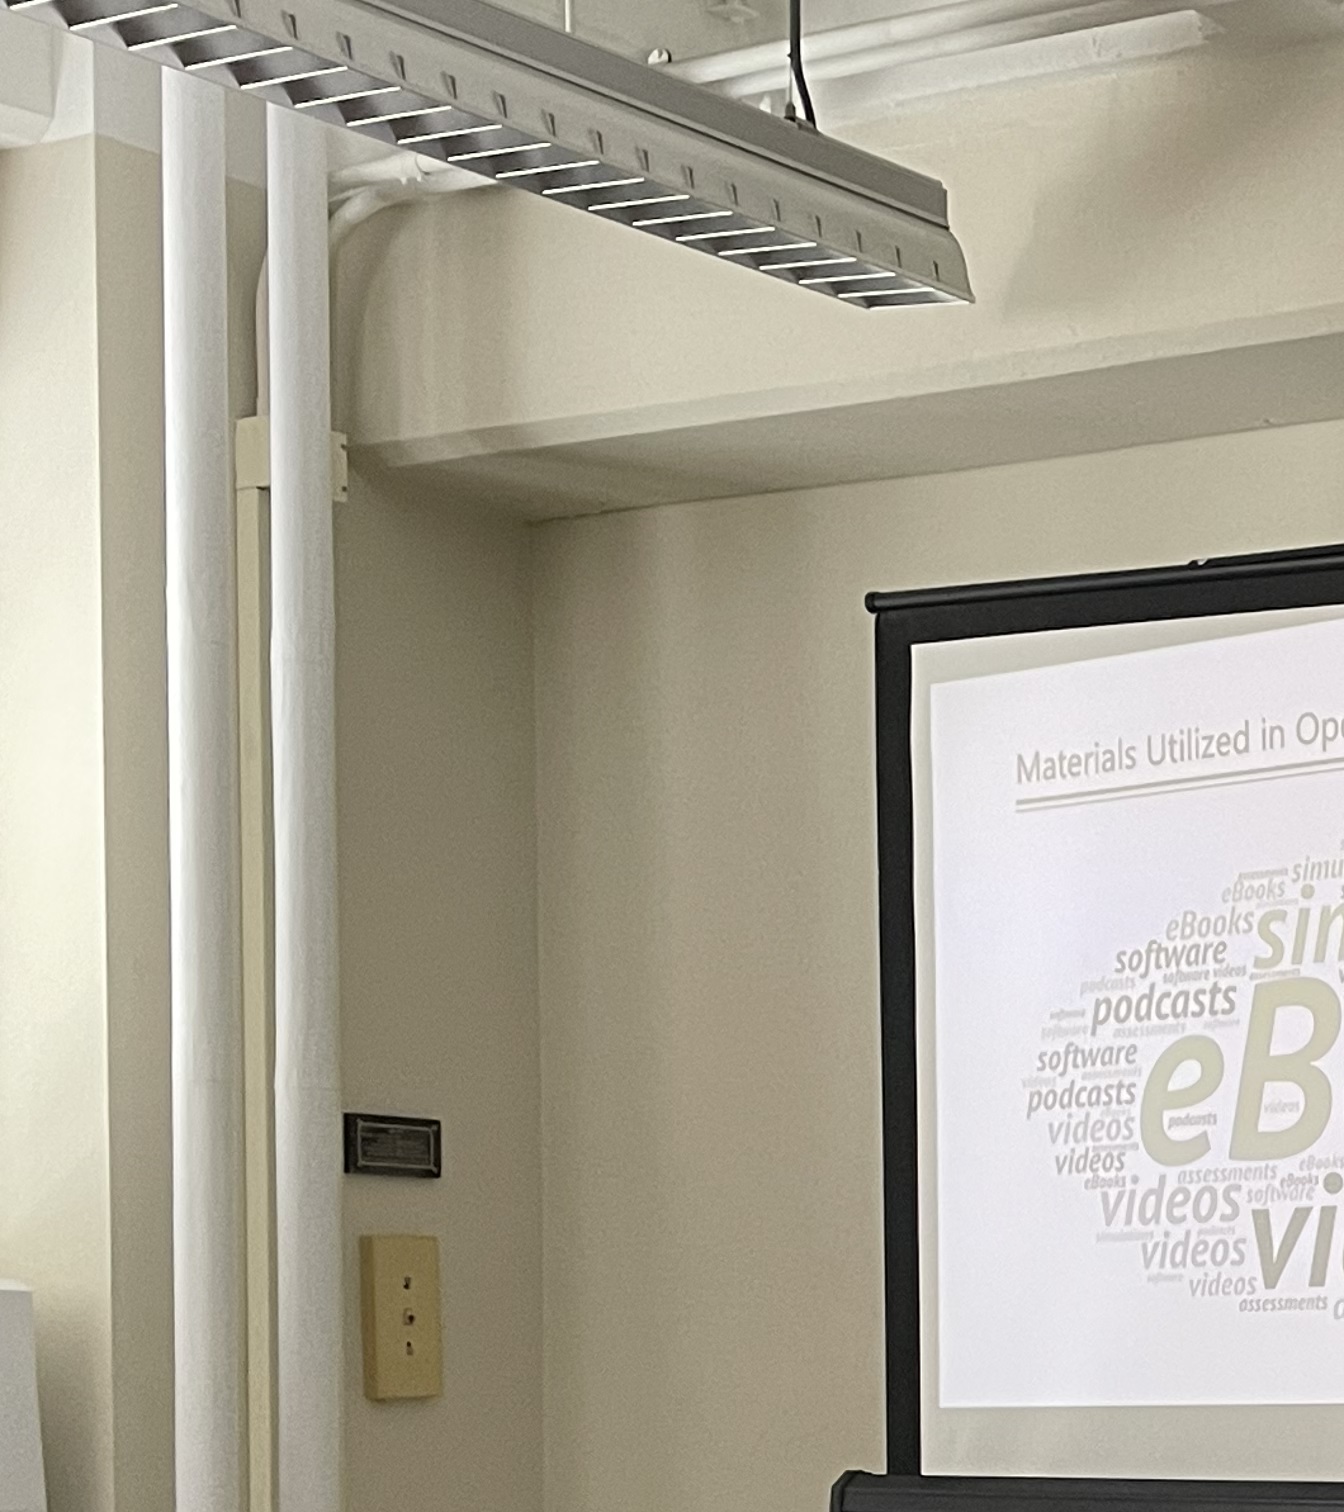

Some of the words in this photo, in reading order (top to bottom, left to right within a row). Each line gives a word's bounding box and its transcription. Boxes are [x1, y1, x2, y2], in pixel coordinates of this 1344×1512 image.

[1016, 737, 1137, 785] Materials
[1147, 720, 1250, 767] Utilized
[1261, 717, 1286, 751] in
[1221, 879, 1285, 903] eBooks
[1165, 906, 1254, 941] eBooks
[1114, 939, 1227, 978] software
[1091, 981, 1237, 1036] podcasts
[1036, 1042, 1137, 1077] software
[1026, 1079, 1137, 1120] podcasts
[1048, 1112, 1135, 1145] videos
[1055, 1148, 1126, 1175] videos
[1178, 1164, 1277, 1184] assessments
[1299, 1154, 1344, 1171] eBooks
[1084, 1175, 1127, 1190] eBooks
[1246, 1183, 1315, 1206] software
[1280, 1174, 1319, 1190] eBooks
[1101, 1174, 1242, 1227] videos
[1141, 1229, 1247, 1269] videos
[1189, 1271, 1258, 1297] videos
[1239, 1296, 1328, 1312] assessments
